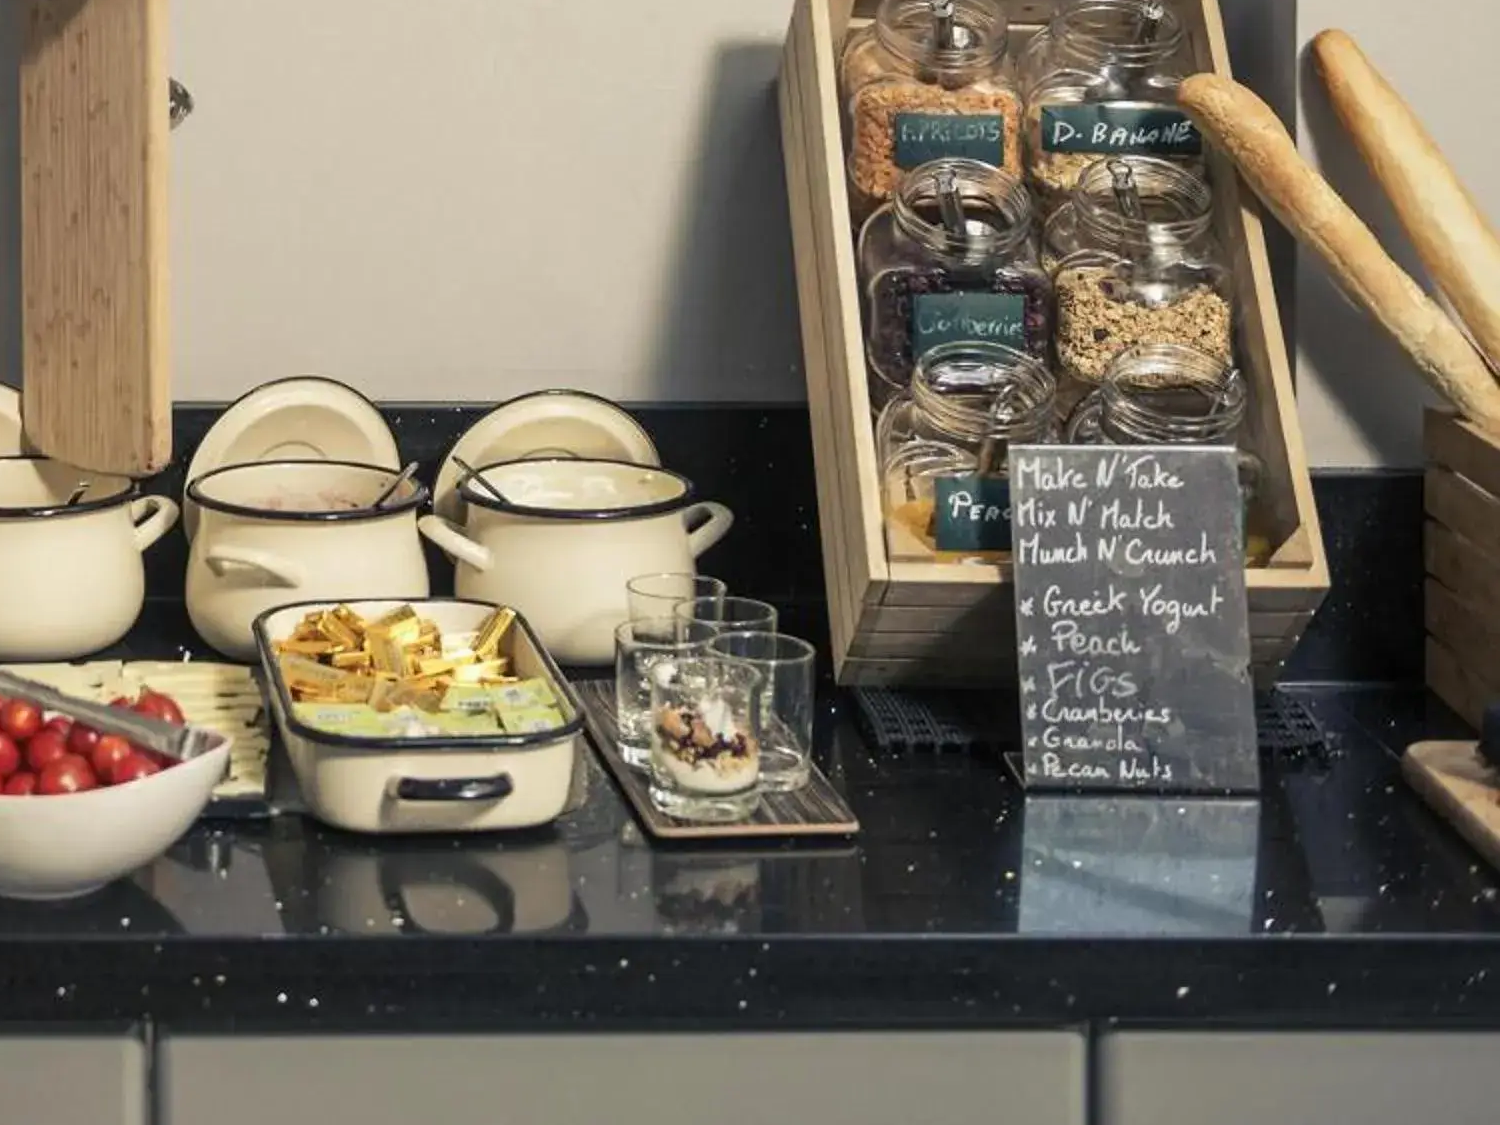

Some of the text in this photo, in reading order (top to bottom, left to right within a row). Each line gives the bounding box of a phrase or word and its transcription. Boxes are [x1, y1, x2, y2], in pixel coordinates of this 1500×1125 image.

[1017, 455, 1088, 490] Make
[1017, 497, 1056, 528] Mix
[1101, 497, 1175, 529] Match
[1019, 531, 1088, 565] Munch
[1124, 530, 1217, 565] Crunch
[1043, 583, 1224, 635] Greek Yogurt
[1051, 619, 1141, 655] Peach
[1042, 725, 1145, 752] Granola
[1041, 752, 1174, 782] Pecan Nuts
